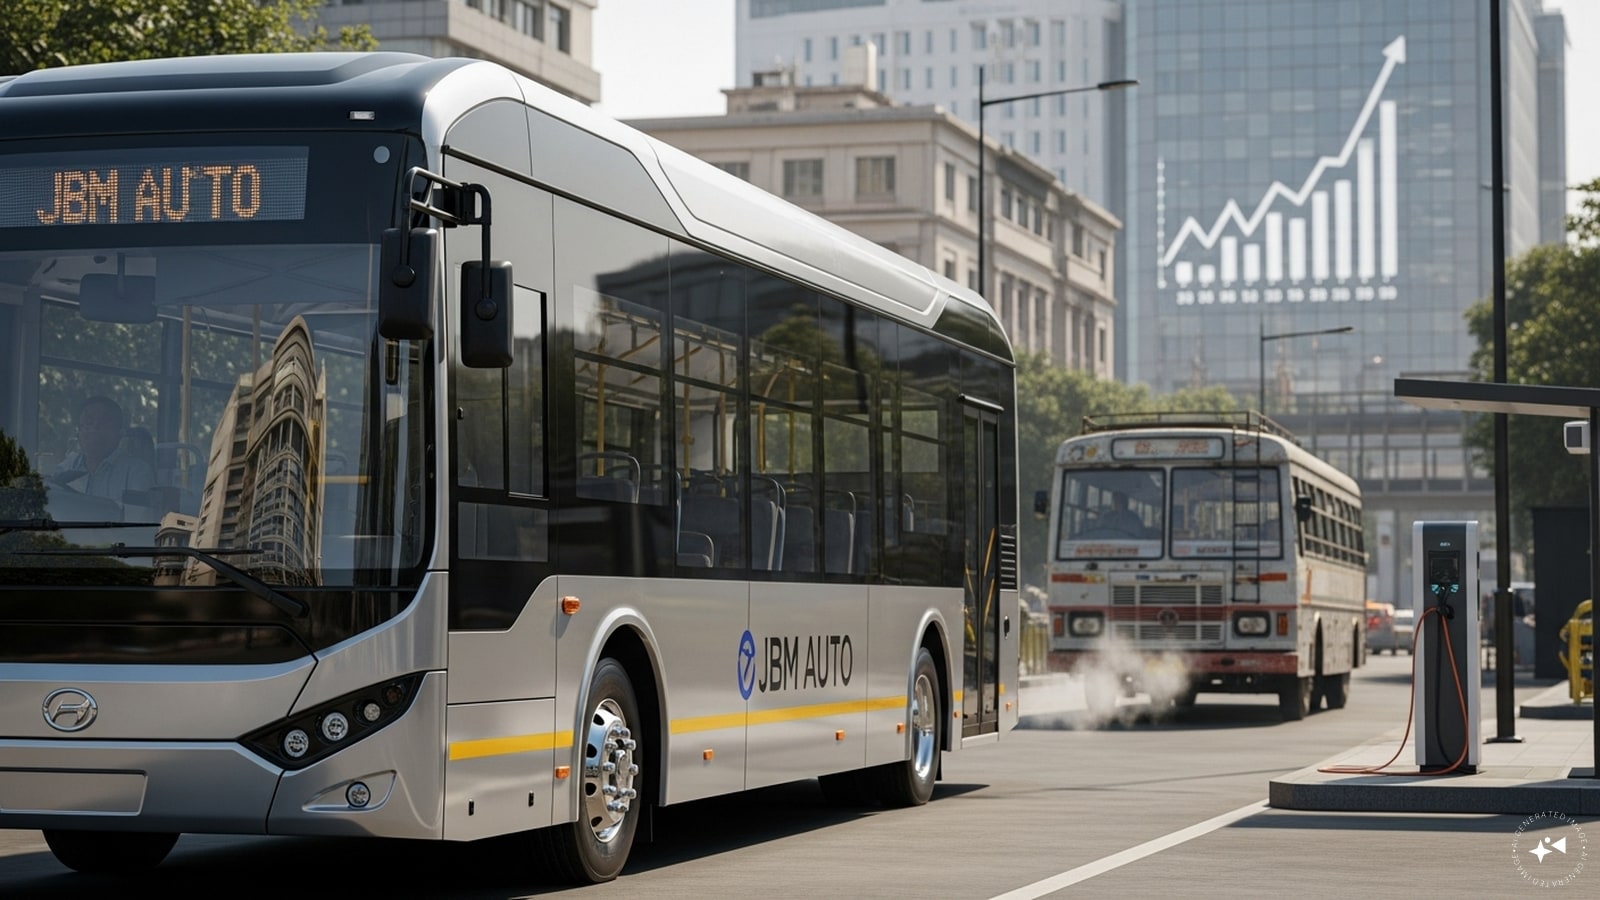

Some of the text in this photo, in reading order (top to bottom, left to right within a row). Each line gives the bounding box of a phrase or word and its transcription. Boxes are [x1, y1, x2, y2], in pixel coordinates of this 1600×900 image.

[36, 164, 262, 225] JBM AUTO
[758, 634, 853, 693] JBM AUTO
